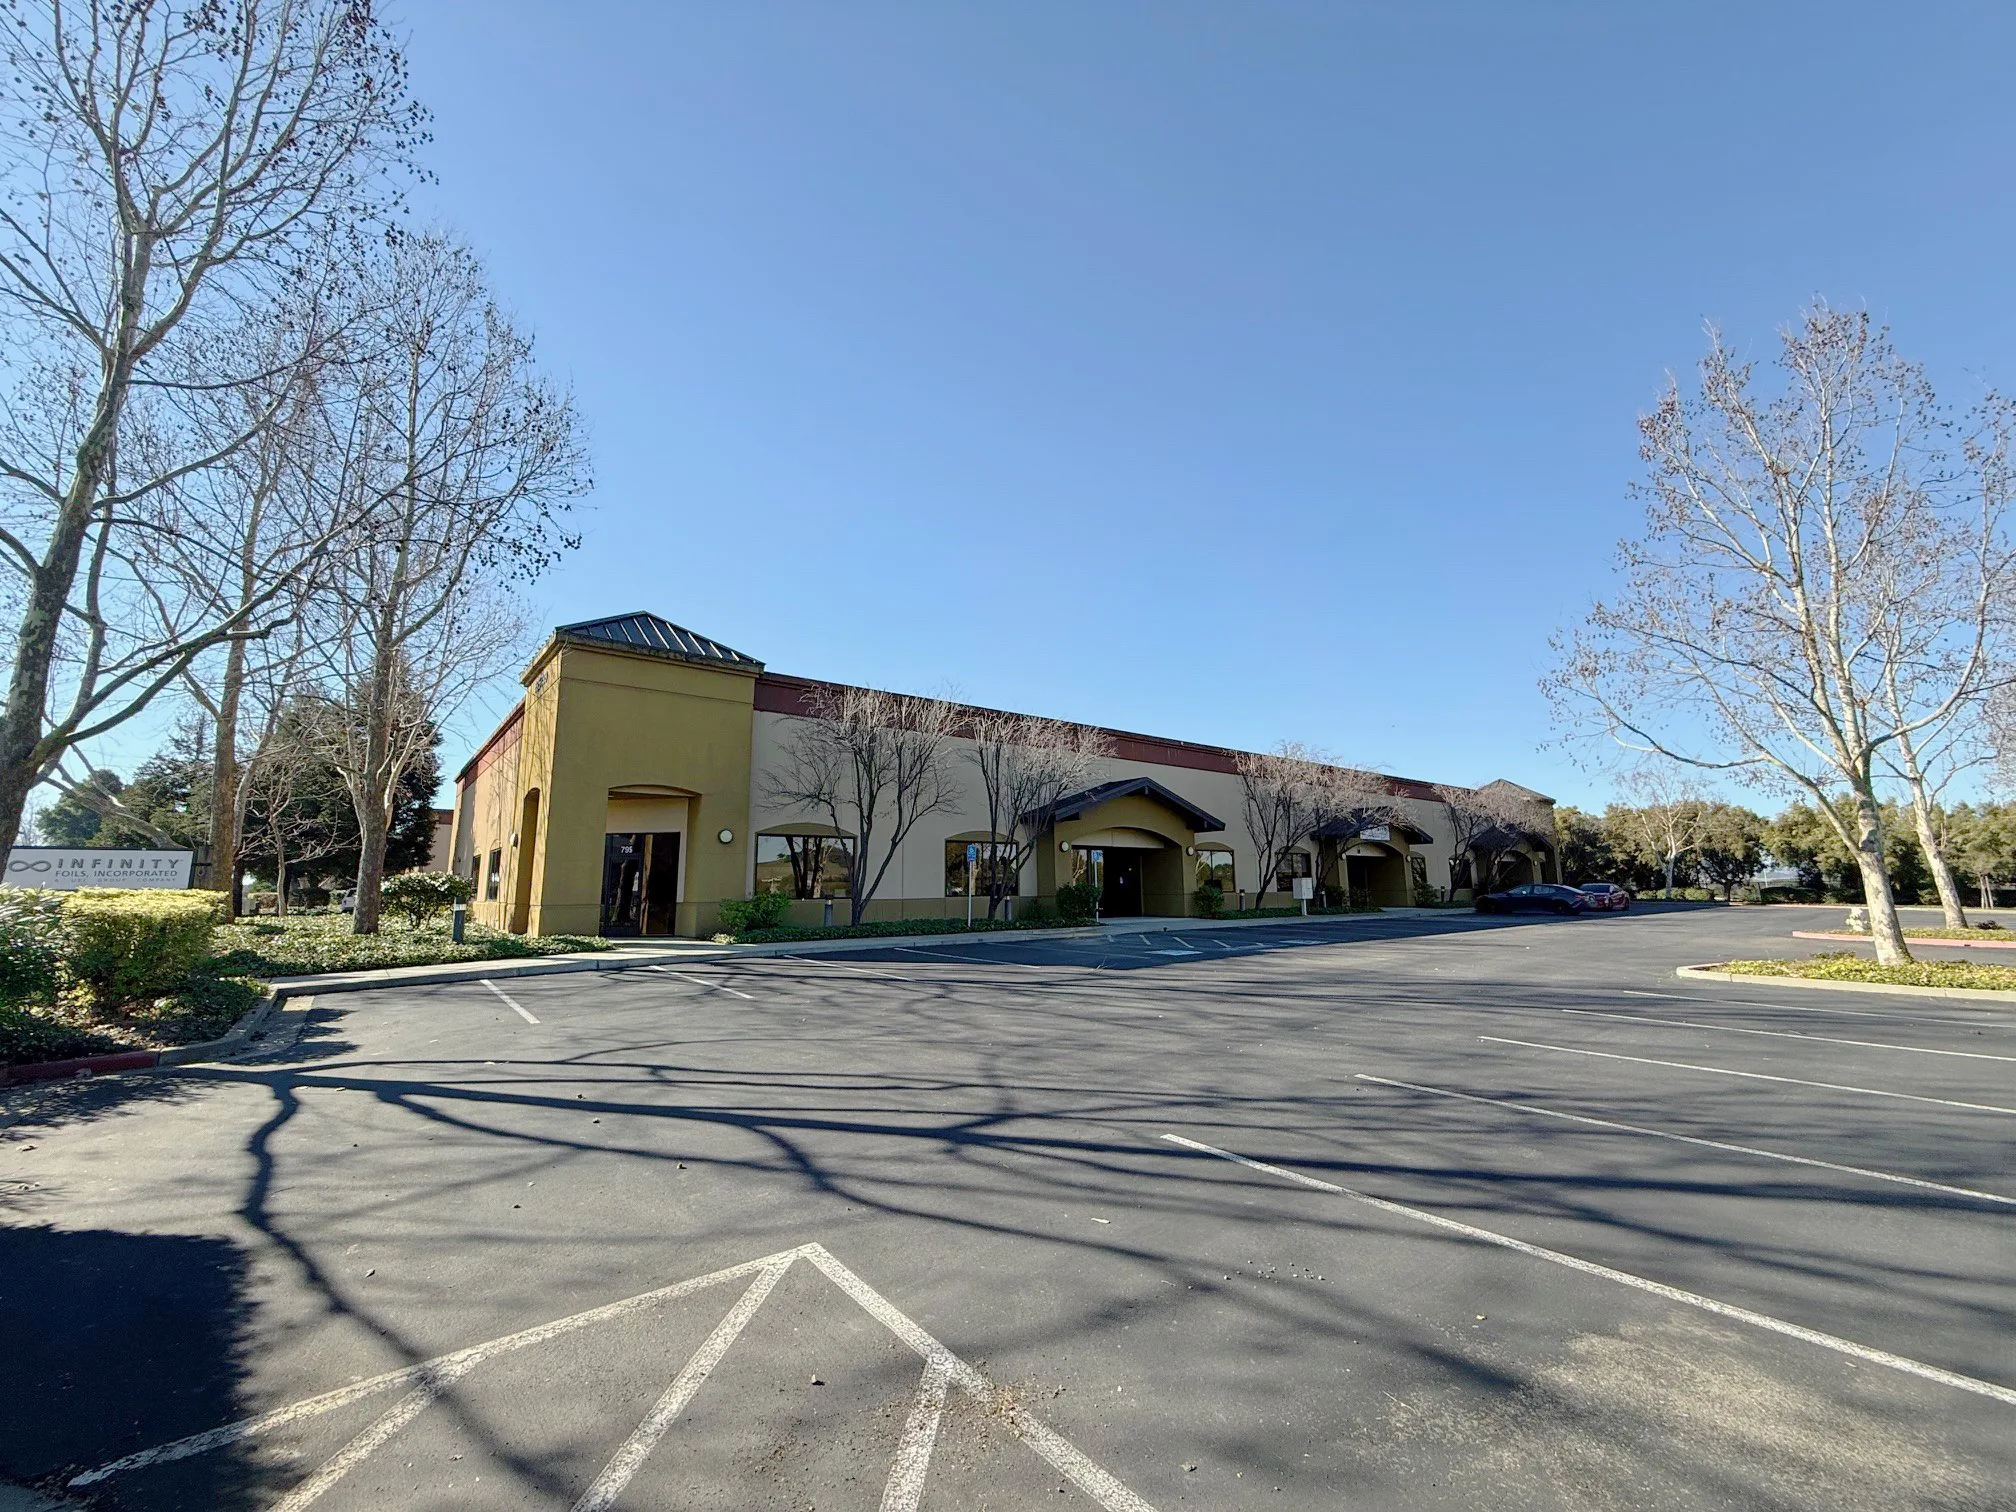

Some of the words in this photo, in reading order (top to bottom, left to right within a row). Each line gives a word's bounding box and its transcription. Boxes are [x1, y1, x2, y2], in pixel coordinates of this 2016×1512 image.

[620, 846, 633, 854] 795
[57, 858, 179, 869] INFINITY
[55, 870, 89, 878] FOILS,
